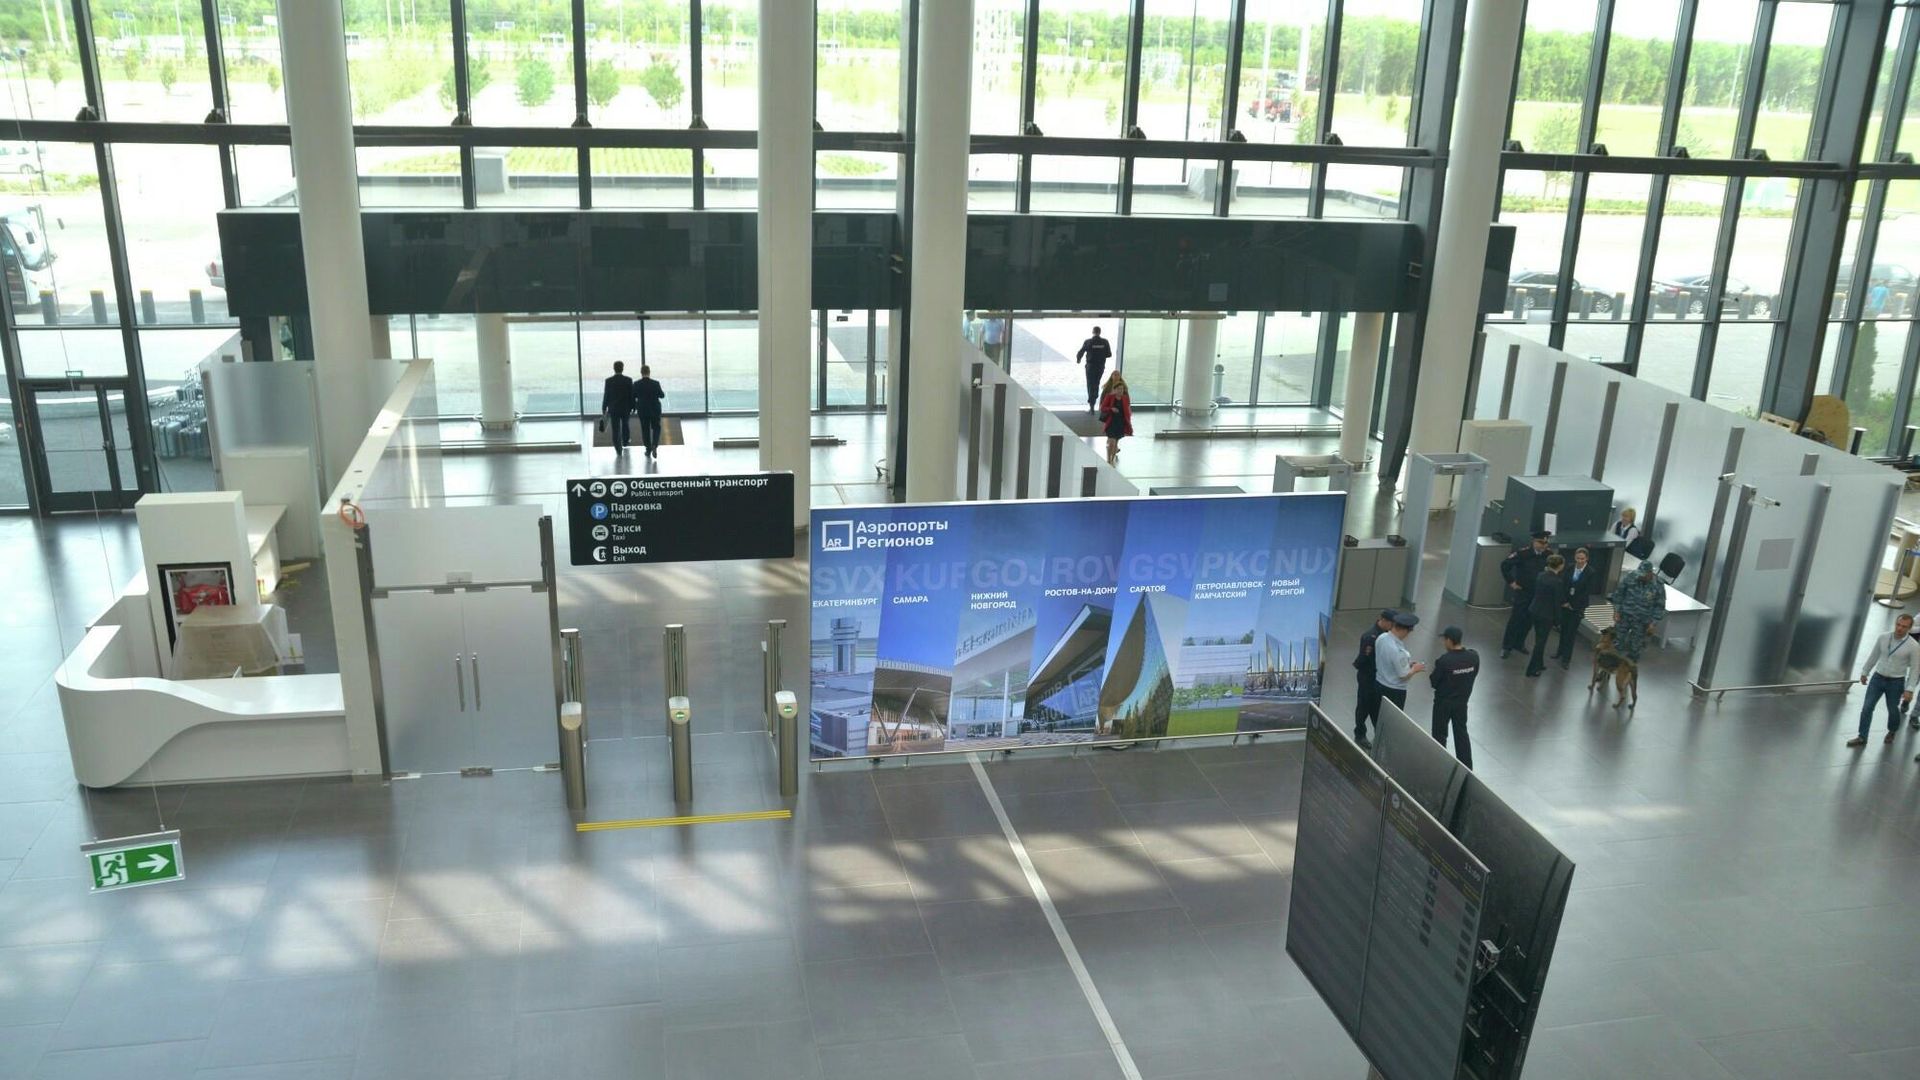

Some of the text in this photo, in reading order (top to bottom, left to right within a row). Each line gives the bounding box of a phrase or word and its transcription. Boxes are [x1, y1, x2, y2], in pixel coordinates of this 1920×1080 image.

[630, 477, 769, 491] Общественный транспорт
[630, 489, 684, 497] Public transport
[610, 502, 663, 513] Парковка
[611, 525, 642, 533] Такси
[856, 520, 949, 535] Аэропорты
[826, 538, 842, 548] AR
[856, 536, 934, 549] Регионов
[613, 546, 647, 555] Выход
[1195, 581, 1266, 591] ПЕТРОПАВЛОВСК-
[1271, 578, 1300, 587] НОВЫЙ
[1044, 586, 1118, 597] РОСТОВ-НА-ДОНУ
[1129, 585, 1167, 593] САРАТОВ
[1270, 587, 1305, 597] УРЕНГОЙ
[893, 596, 929, 604] САМАРА
[971, 591, 1008, 600] НИЖНИЙ
[1194, 590, 1247, 600] КАМЧАТСКИЙ
[812, 598, 878, 608] ЕКАТЕРИНБУРГ
[970, 600, 1017, 610] НОВГОРОД
